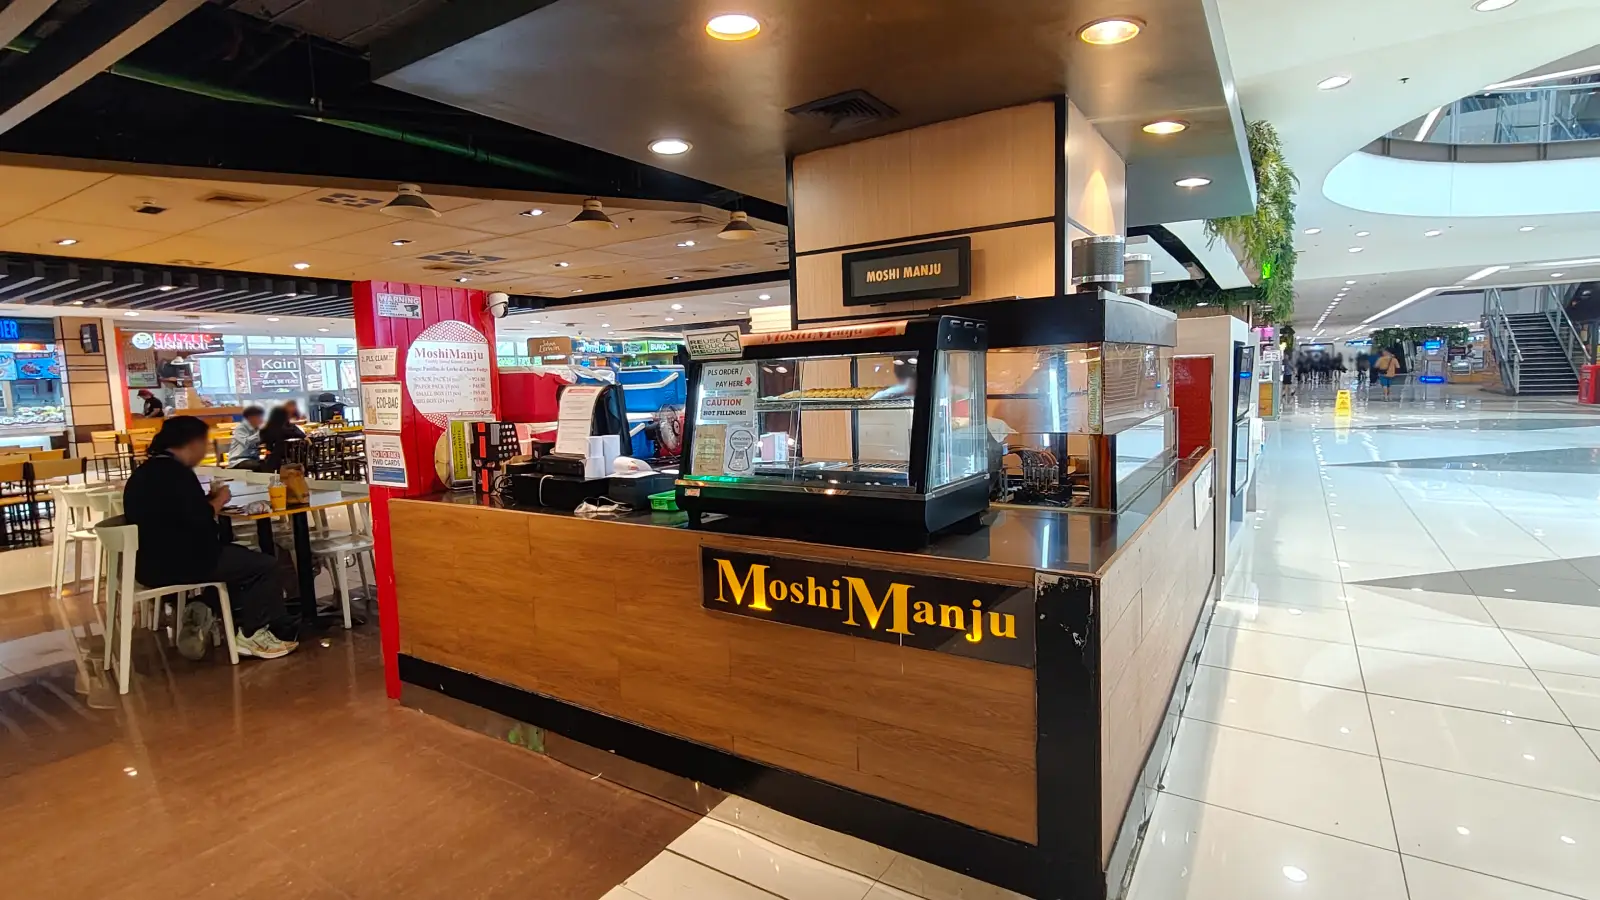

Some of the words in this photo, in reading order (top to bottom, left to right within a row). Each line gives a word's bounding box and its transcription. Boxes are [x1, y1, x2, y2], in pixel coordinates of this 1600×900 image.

[866, 267, 900, 283] MOSHI
[903, 263, 942, 279] MANJU
[379, 295, 420, 305] WARNING
[414, 347, 484, 361] MoshiManju
[261, 358, 297, 370] Kain
[718, 368, 739, 376] ORDER
[376, 396, 399, 409] ECO-BAG
[706, 399, 742, 407] CAUTION
[372, 458, 383, 466] PWD
[713, 557, 1018, 643] MoshiManju
